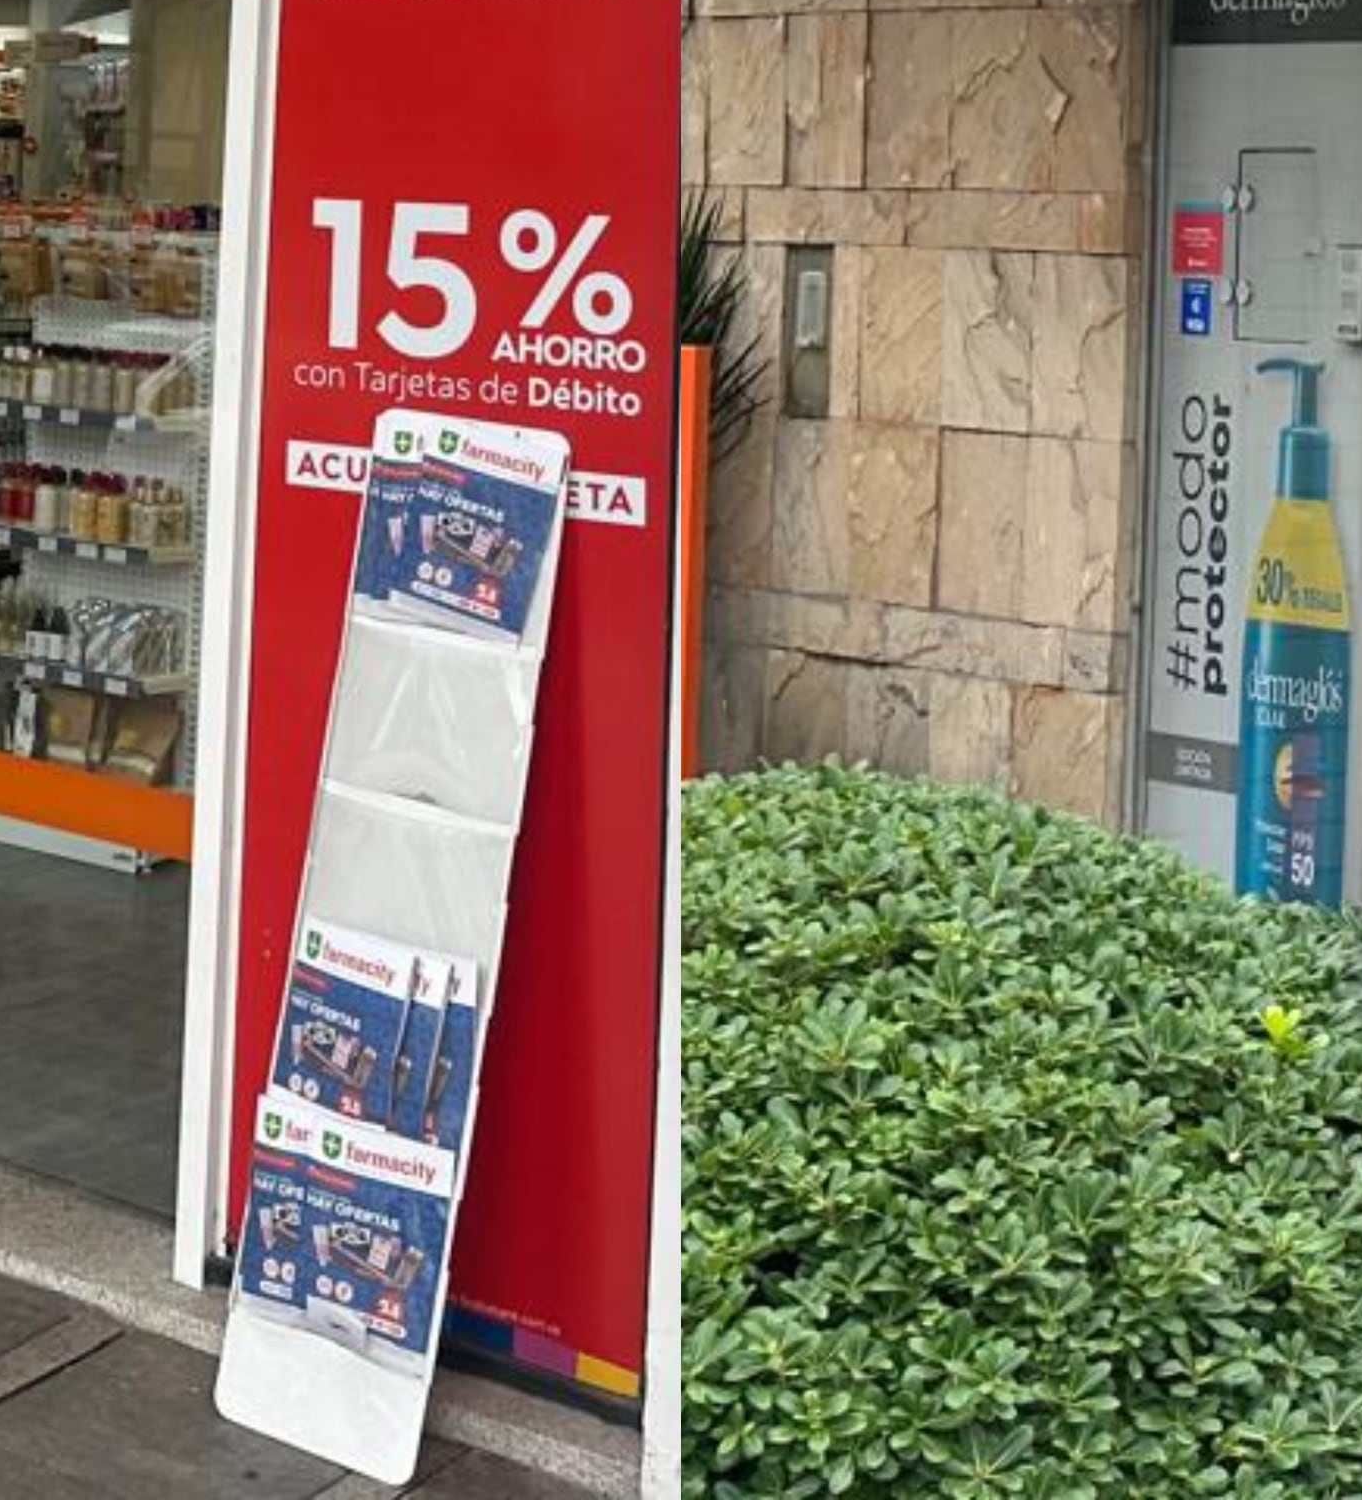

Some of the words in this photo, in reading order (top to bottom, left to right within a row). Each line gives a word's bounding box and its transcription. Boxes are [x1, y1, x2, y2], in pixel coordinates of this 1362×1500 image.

[312, 198, 633, 359] 15%
[492, 332, 647, 374] AHORRO
[294, 363, 345, 390] con
[354, 361, 470, 403] Tarjetas
[479, 373, 518, 406] de
[528, 377, 641, 417] Débito
[462, 438, 545, 479] farmacity
[1167, 394, 1208, 691] #modo
[1203, 394, 1234, 697] protector
[1247, 654, 1343, 723] dermaglós
[323, 940, 396, 986] farmacity
[346, 1140, 437, 1185] farmacity
